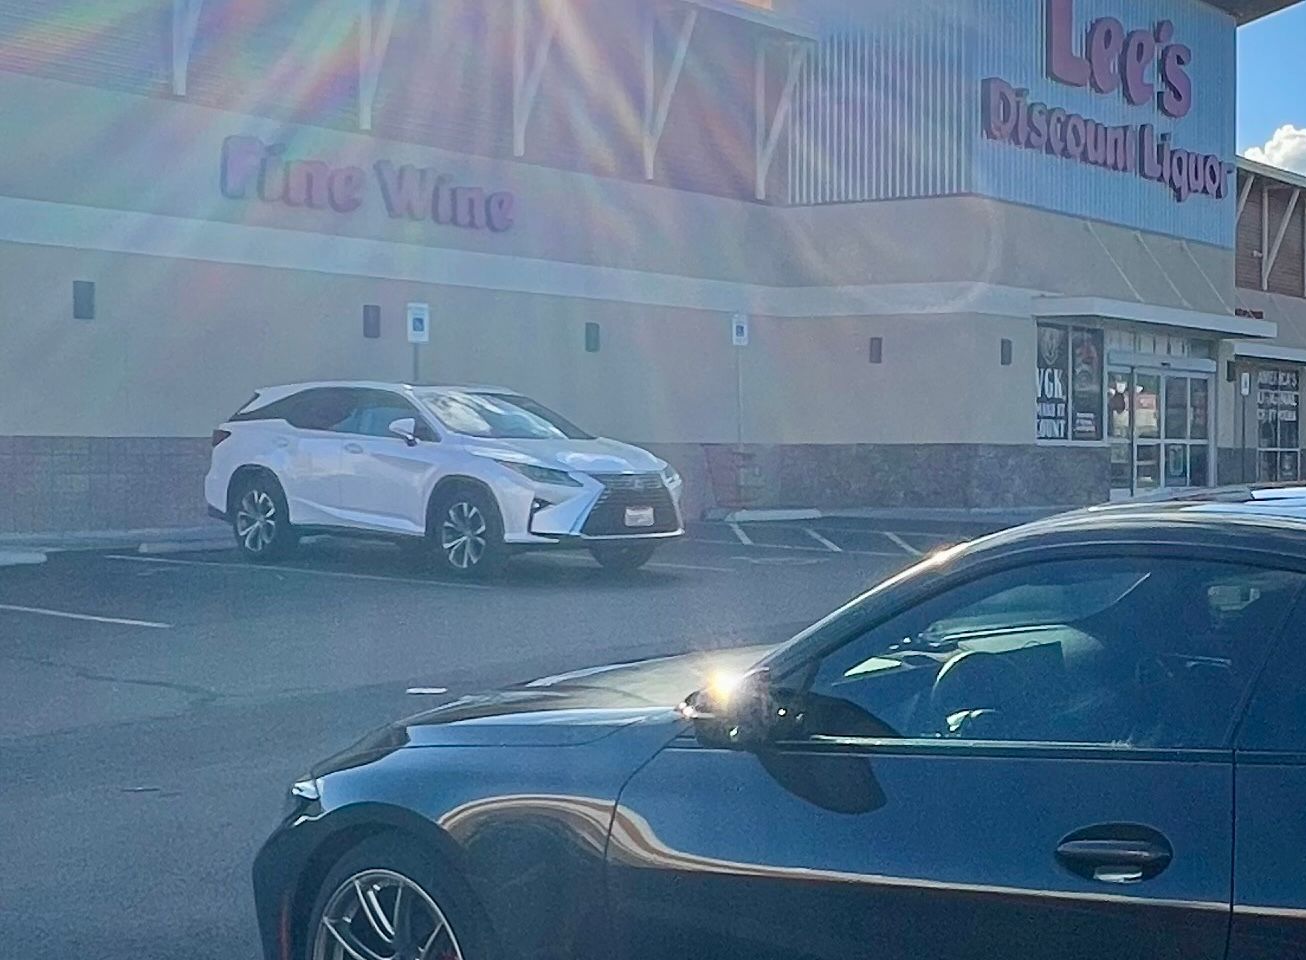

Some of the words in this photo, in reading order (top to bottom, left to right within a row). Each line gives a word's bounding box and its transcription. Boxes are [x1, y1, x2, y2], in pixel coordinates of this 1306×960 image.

[1043, 0, 1192, 118] Lee's
[220, 135, 365, 213] Fine
[373, 158, 516, 232] Wine
[981, 77, 1138, 176] Discount
[1138, 123, 1235, 202] Liquor
